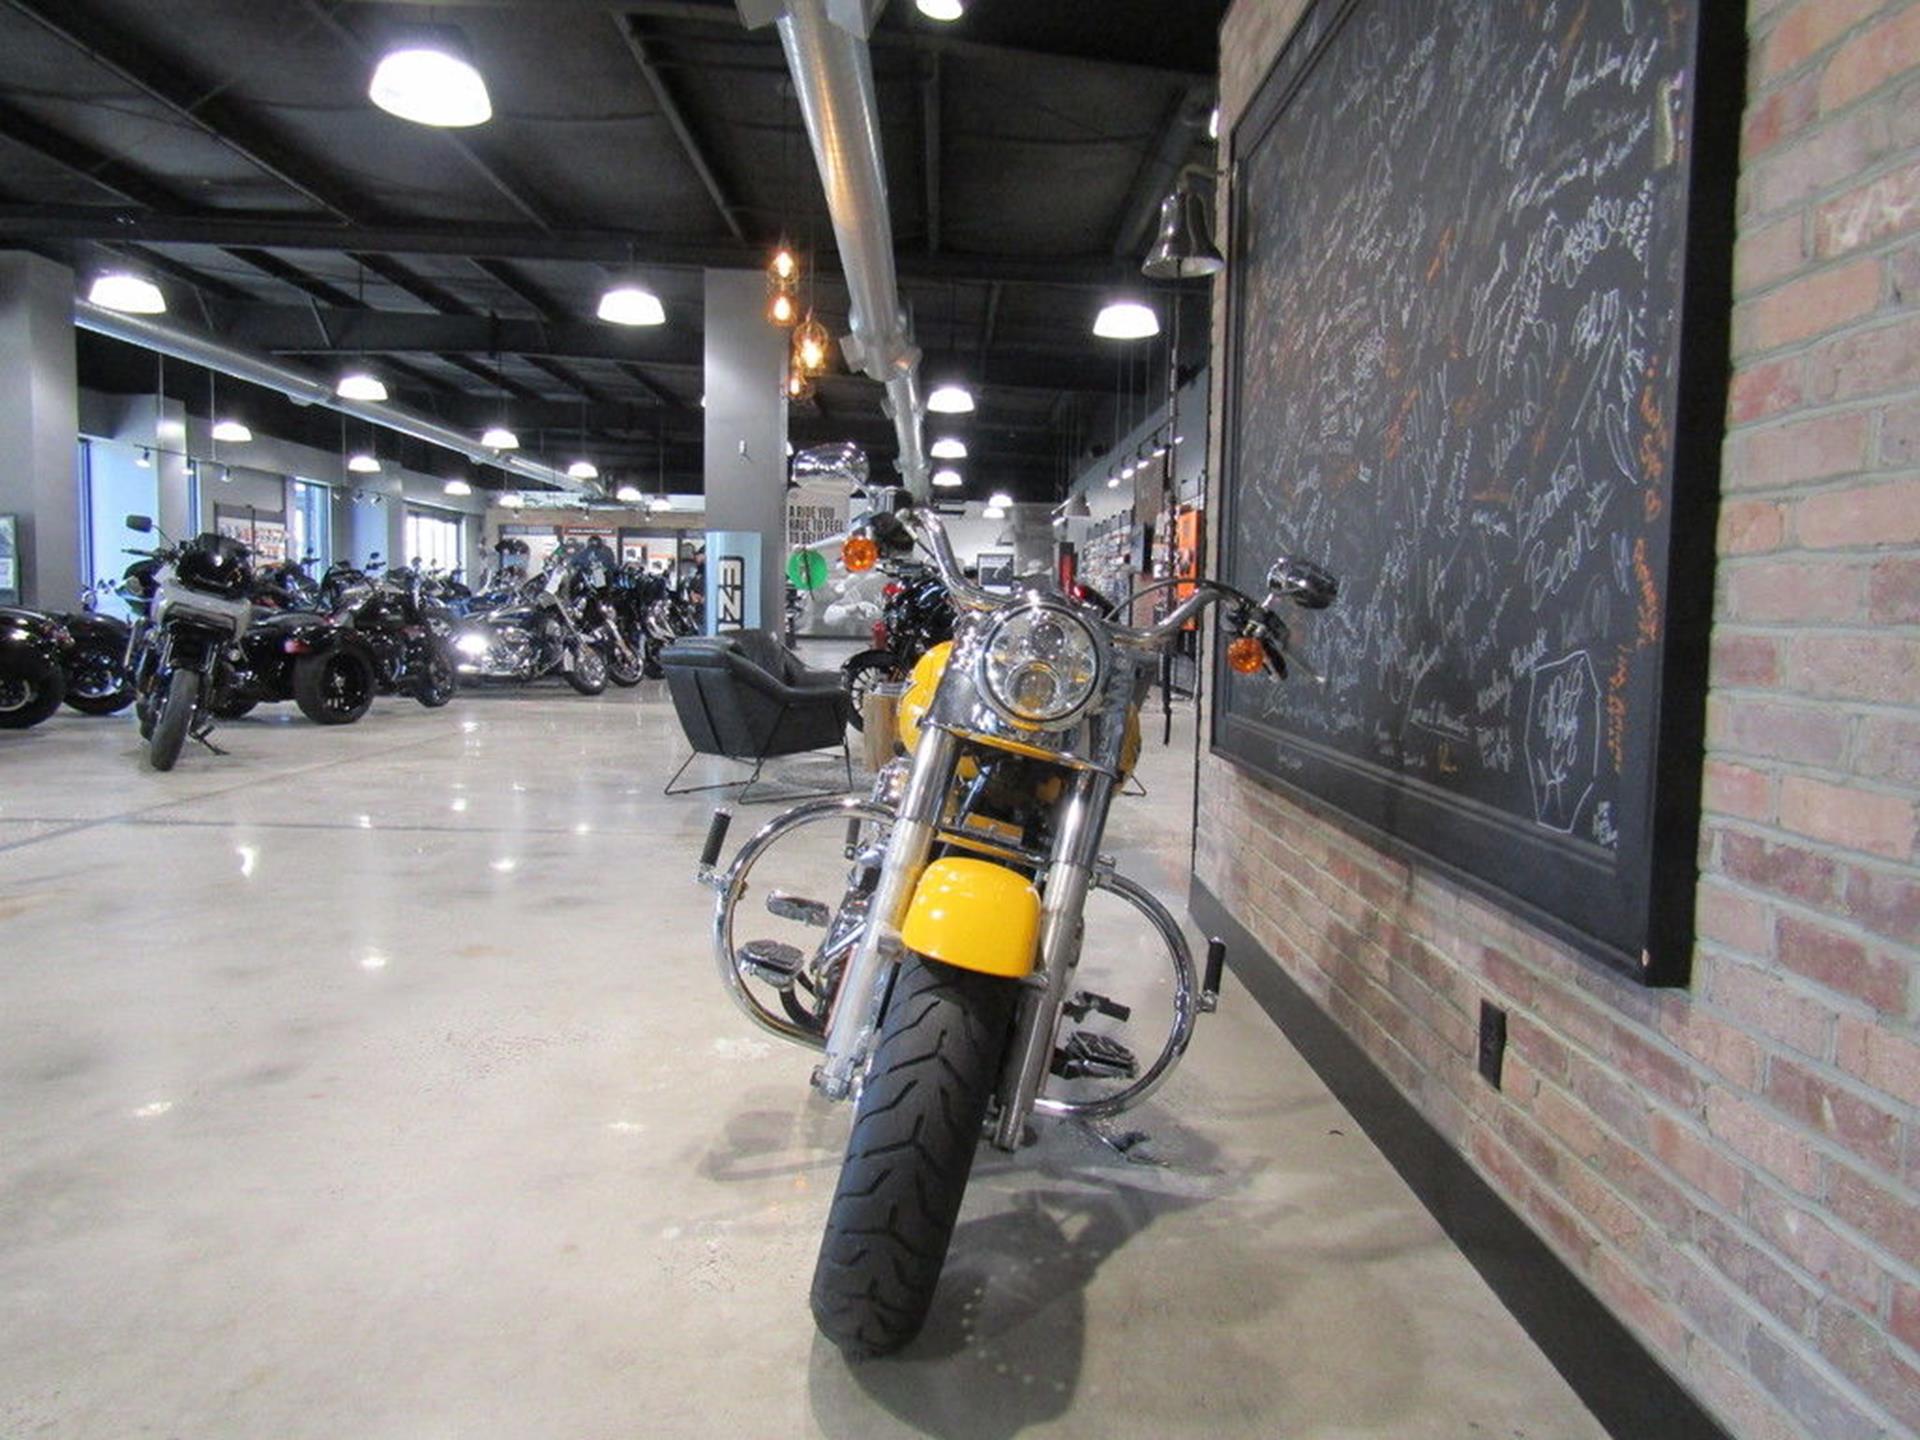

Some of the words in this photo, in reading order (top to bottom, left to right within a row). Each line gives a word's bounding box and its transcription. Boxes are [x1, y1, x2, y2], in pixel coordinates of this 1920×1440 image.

[789, 505, 795, 517] A
[797, 506, 816, 518] RIDE
[818, 507, 835, 519] YOU
[789, 518, 810, 531] HAVE
[812, 519, 824, 532] TO
[826, 520, 844, 533] FEEL
